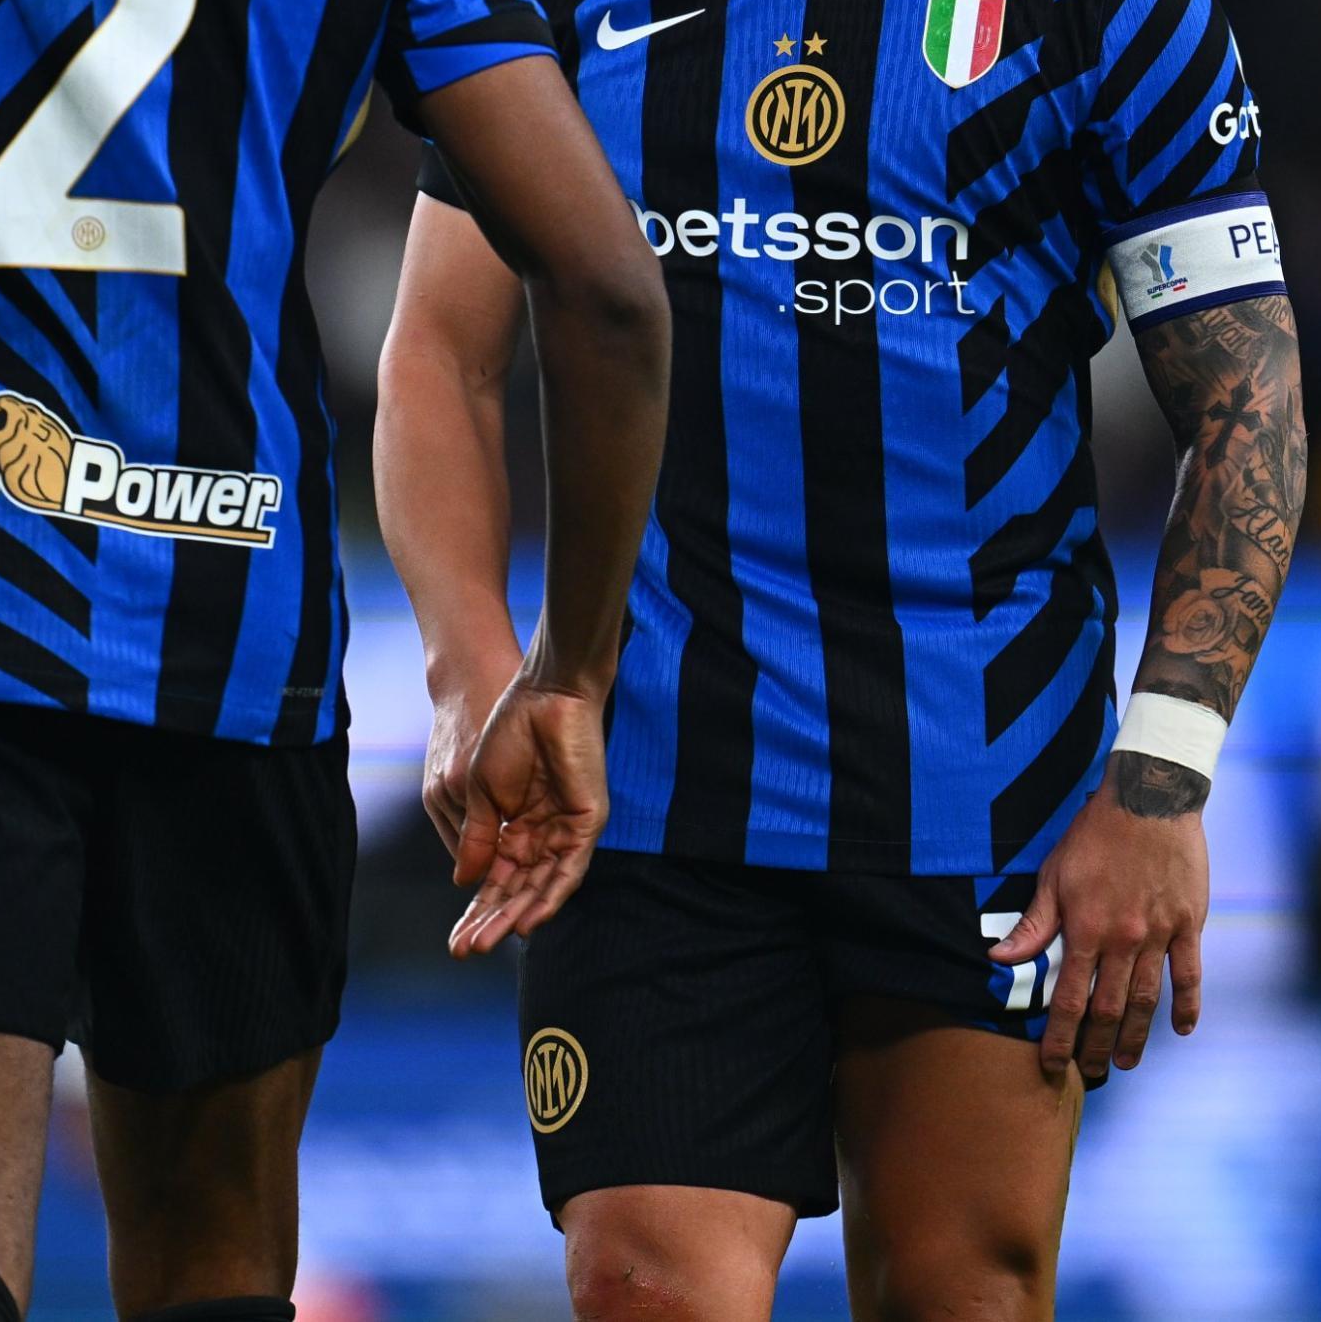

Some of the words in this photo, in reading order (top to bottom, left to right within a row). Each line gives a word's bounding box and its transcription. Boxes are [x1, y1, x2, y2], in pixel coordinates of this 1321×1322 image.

[778, 270, 976, 326] .sport
[1146, 276, 1189, 296] SUPERCOPPA
[63, 437, 280, 530] Power
